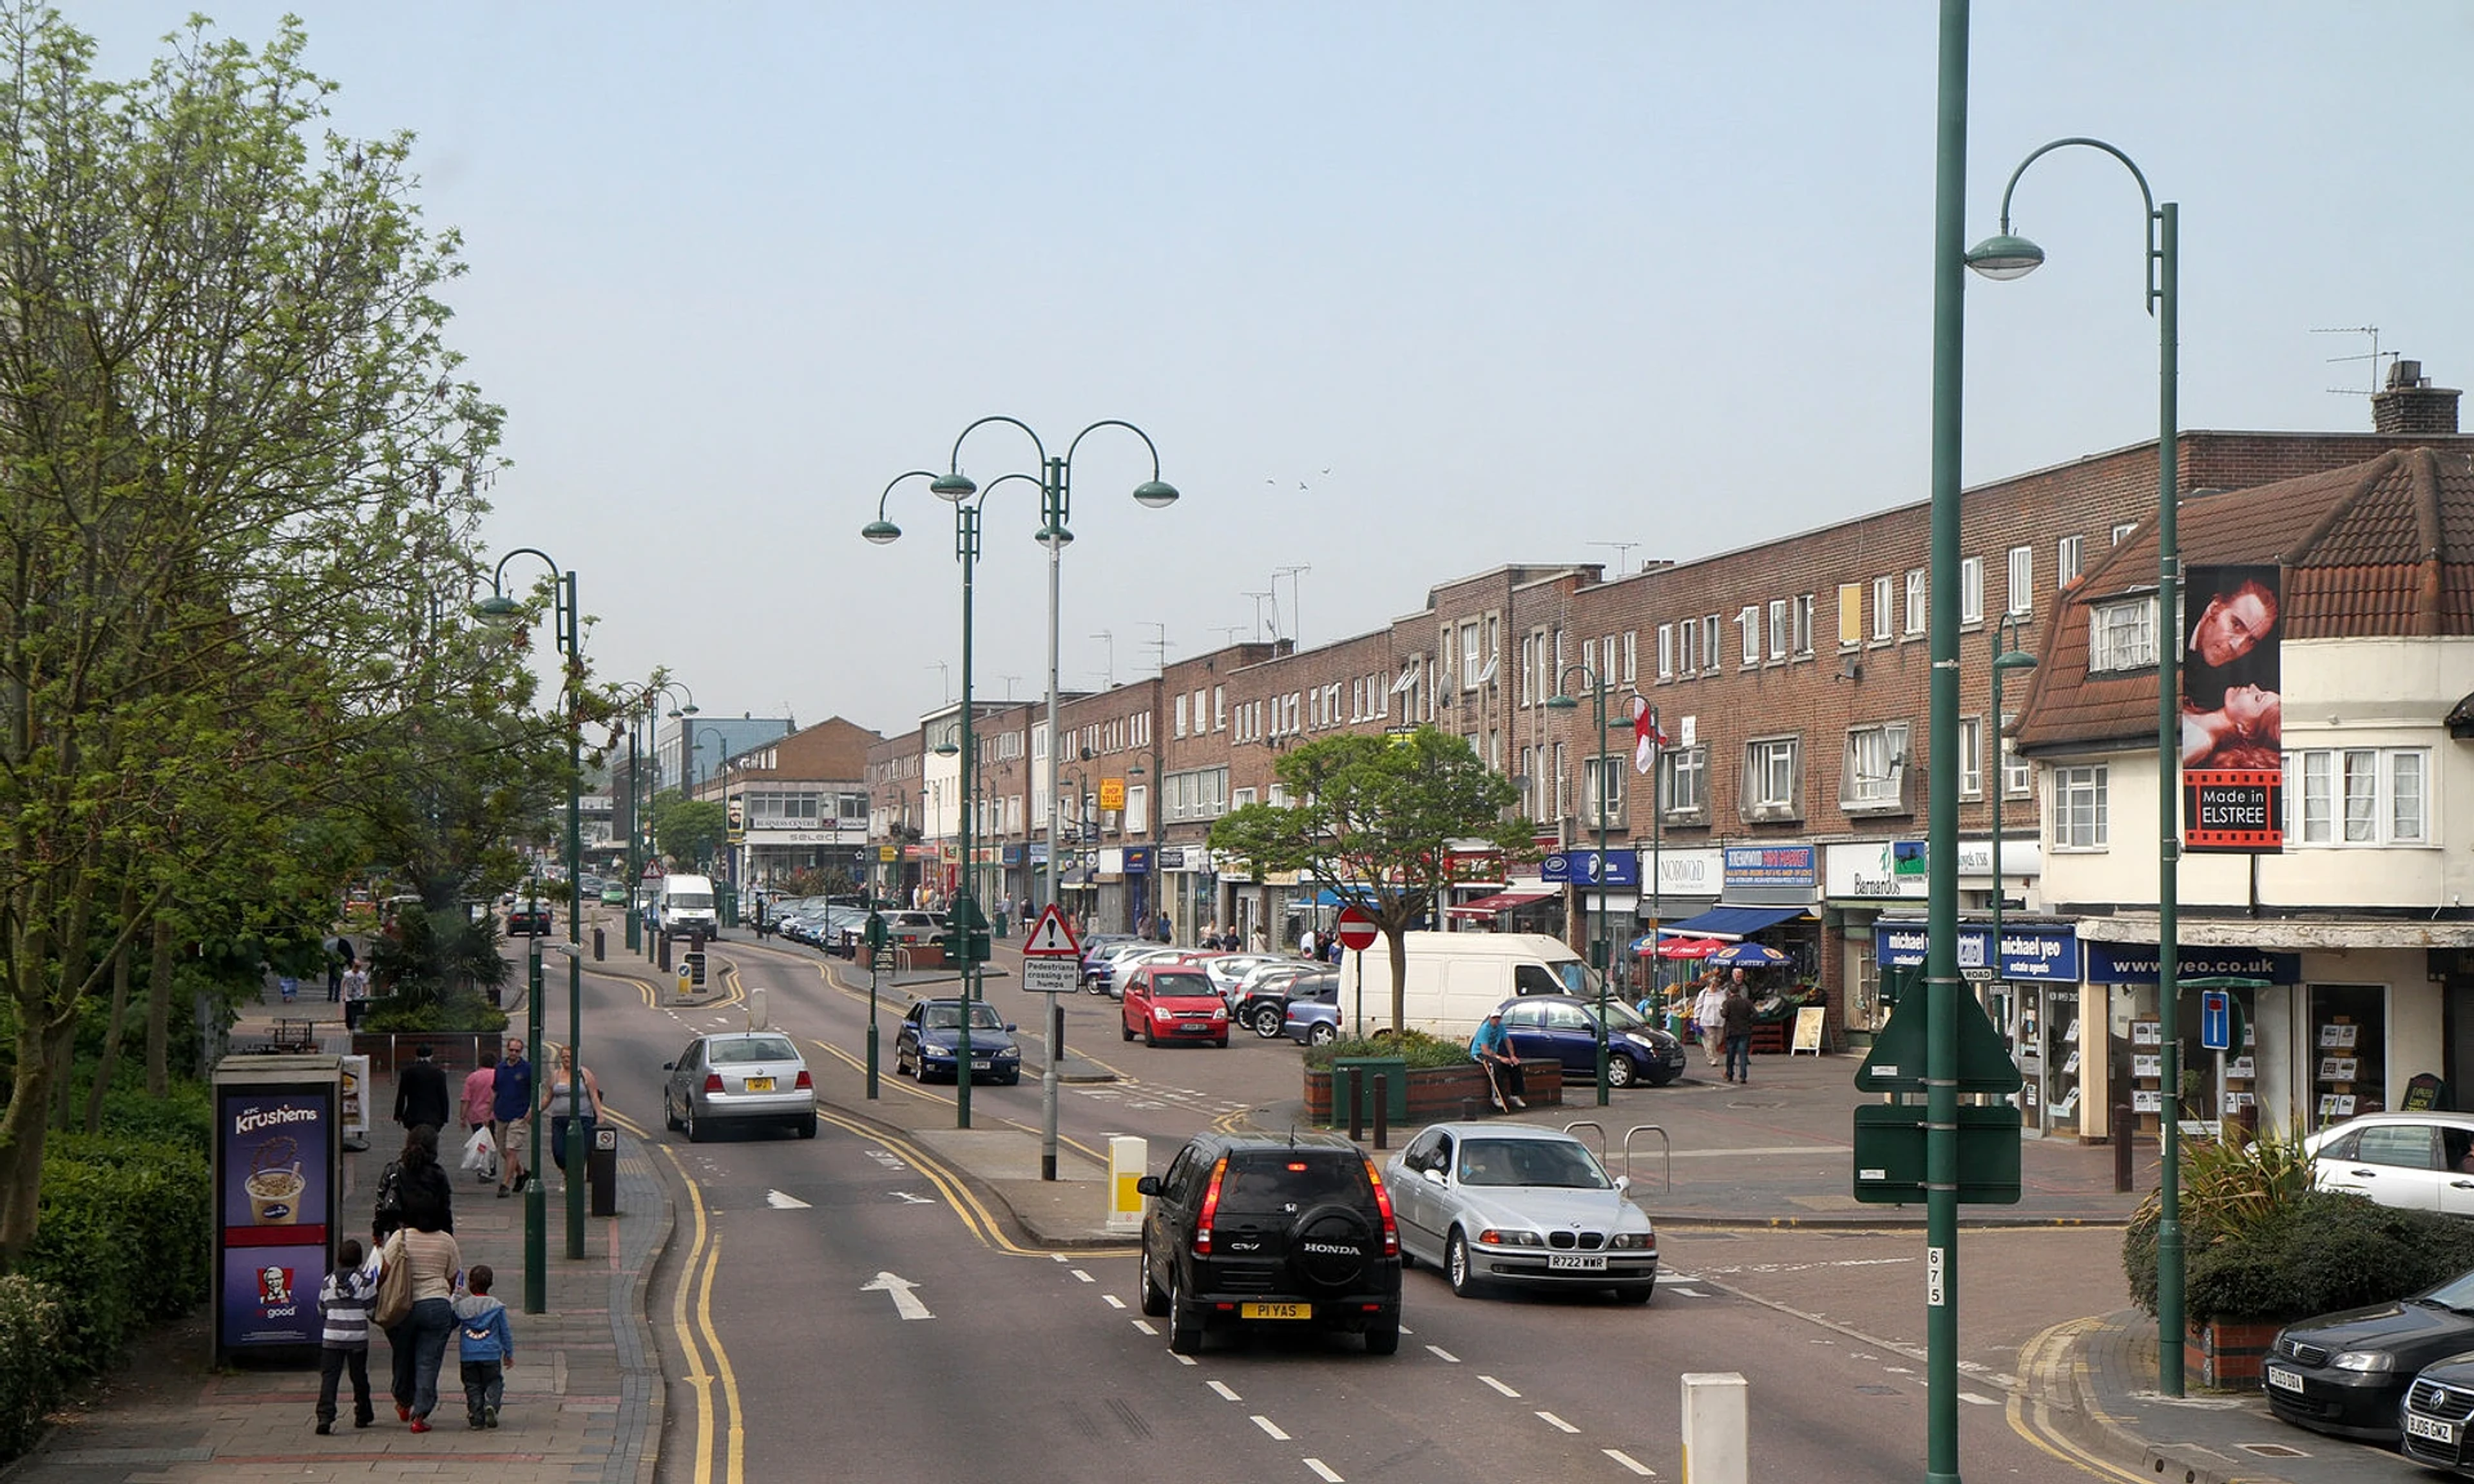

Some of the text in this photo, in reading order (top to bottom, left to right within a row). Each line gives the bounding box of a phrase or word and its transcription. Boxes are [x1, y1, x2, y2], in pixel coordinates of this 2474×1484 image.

[2203, 790, 2264, 803] Made in
[2202, 806, 2265, 824] ELSTREE
[1889, 931, 1925, 950] michael
[2040, 941, 2060, 961] yeo
[1028, 962, 1075, 971] Pedestrians
[1304, 1242, 1361, 1255] HONDA
[1553, 1257, 1581, 1268] R722
[267, 1307, 296, 1319] good
